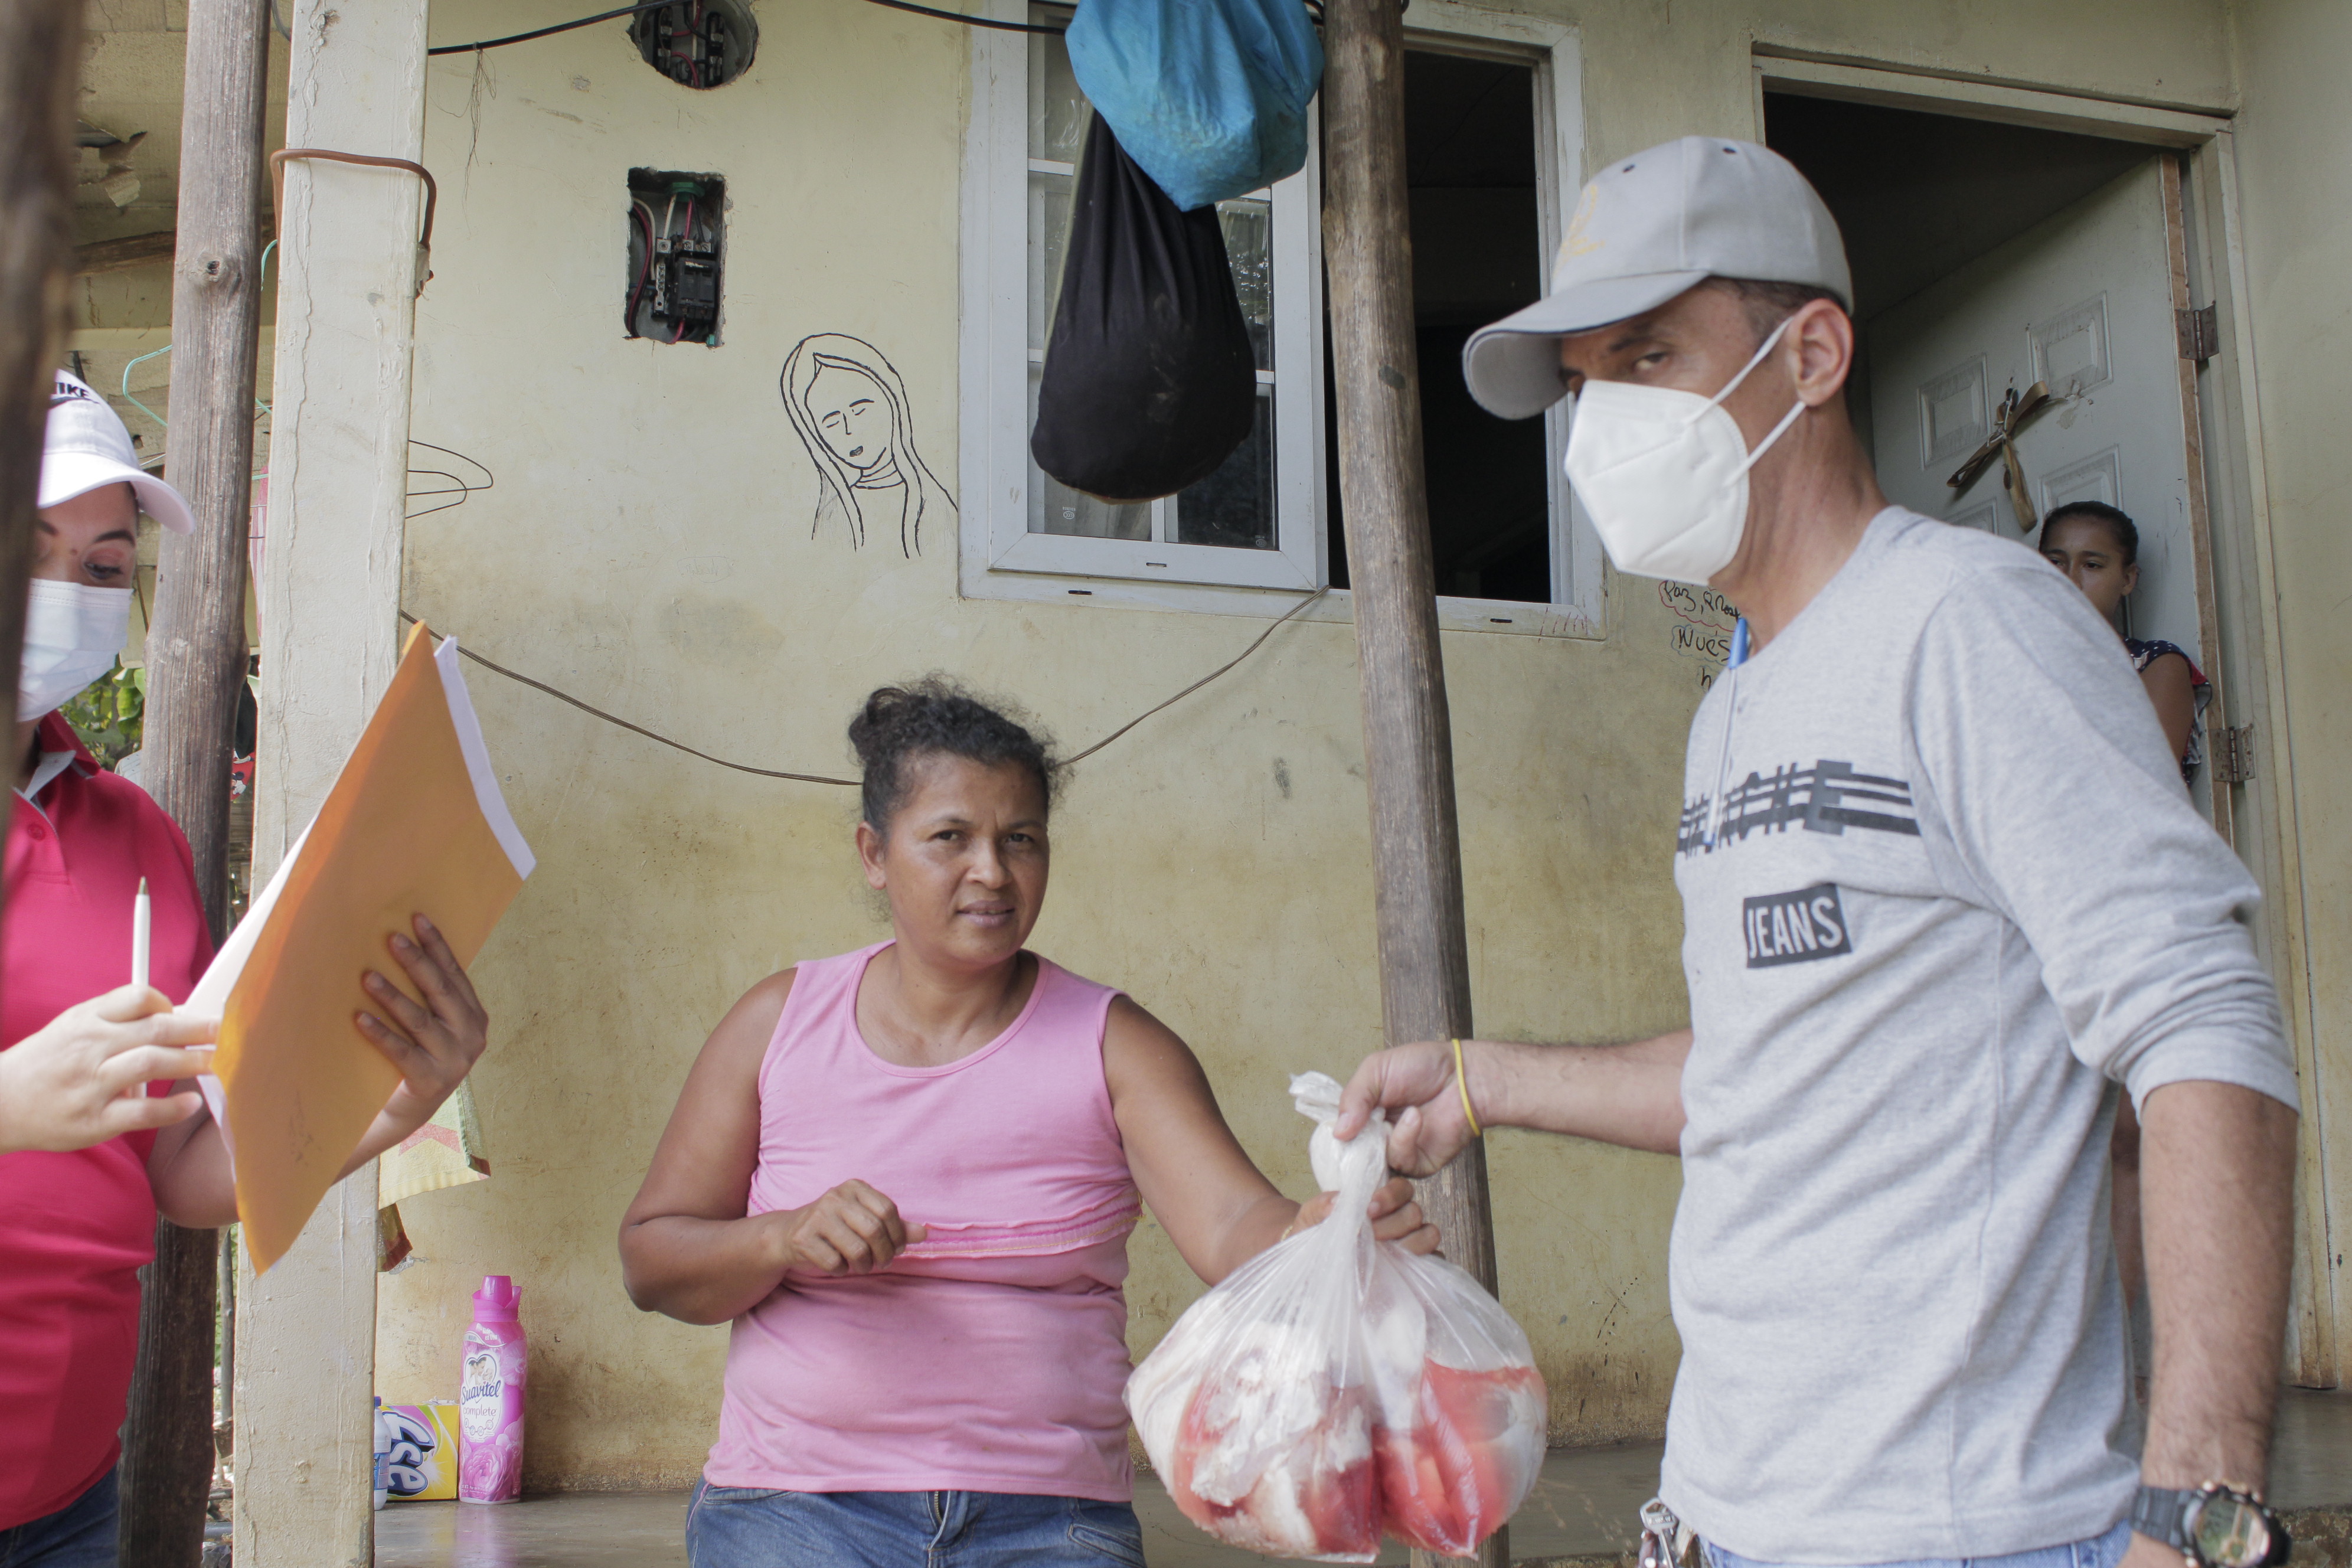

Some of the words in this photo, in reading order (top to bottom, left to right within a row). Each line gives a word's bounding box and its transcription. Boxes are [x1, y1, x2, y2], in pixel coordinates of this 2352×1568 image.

[1746, 896, 1843, 959] JEANS
[462, 1380, 501, 1405] Suavitel
[463, 1404, 496, 1419] complete
